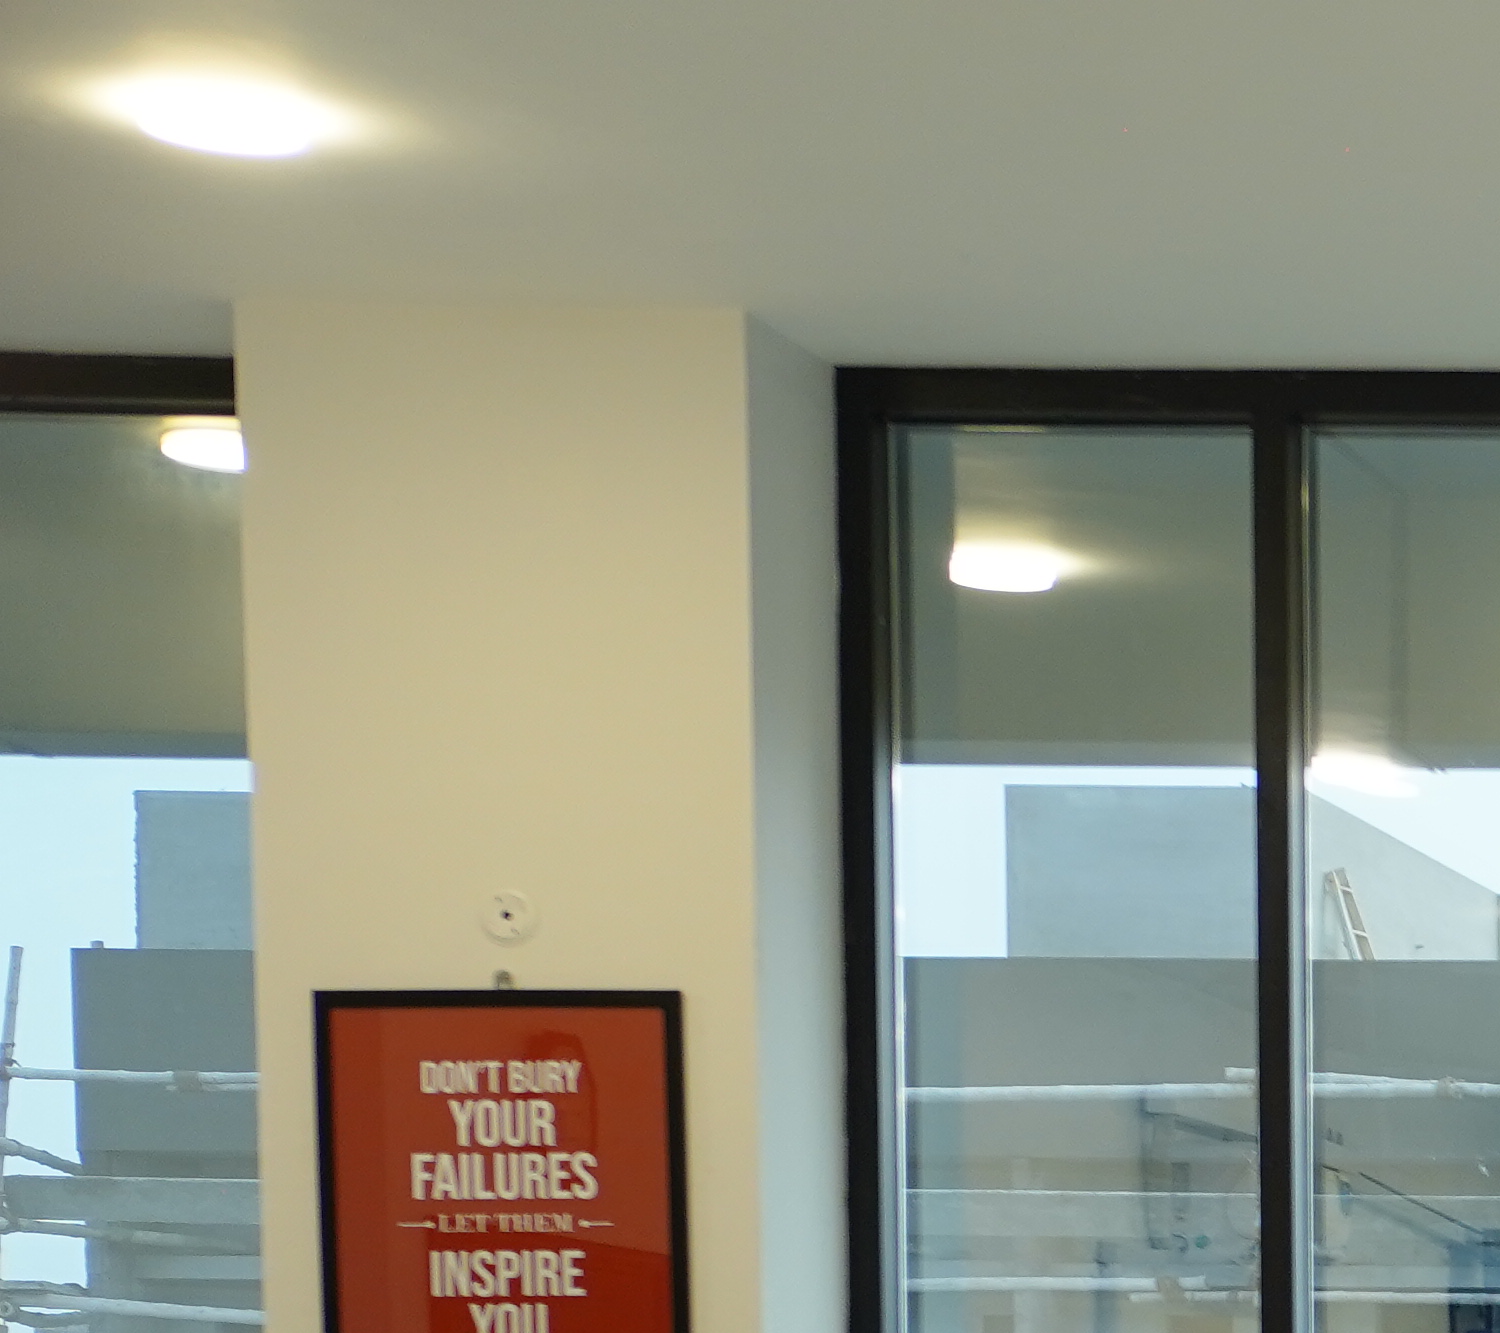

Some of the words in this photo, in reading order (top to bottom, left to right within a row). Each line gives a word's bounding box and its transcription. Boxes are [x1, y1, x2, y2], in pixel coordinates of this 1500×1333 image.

[419, 1060, 504, 1094] DON'T
[507, 1060, 582, 1094] BURY
[448, 1099, 557, 1147] YOUR
[409, 1152, 599, 1200] FAILURES
[438, 1213, 492, 1233] LET
[494, 1213, 574, 1233] THEM
[429, 1249, 587, 1297] INSPIRE
